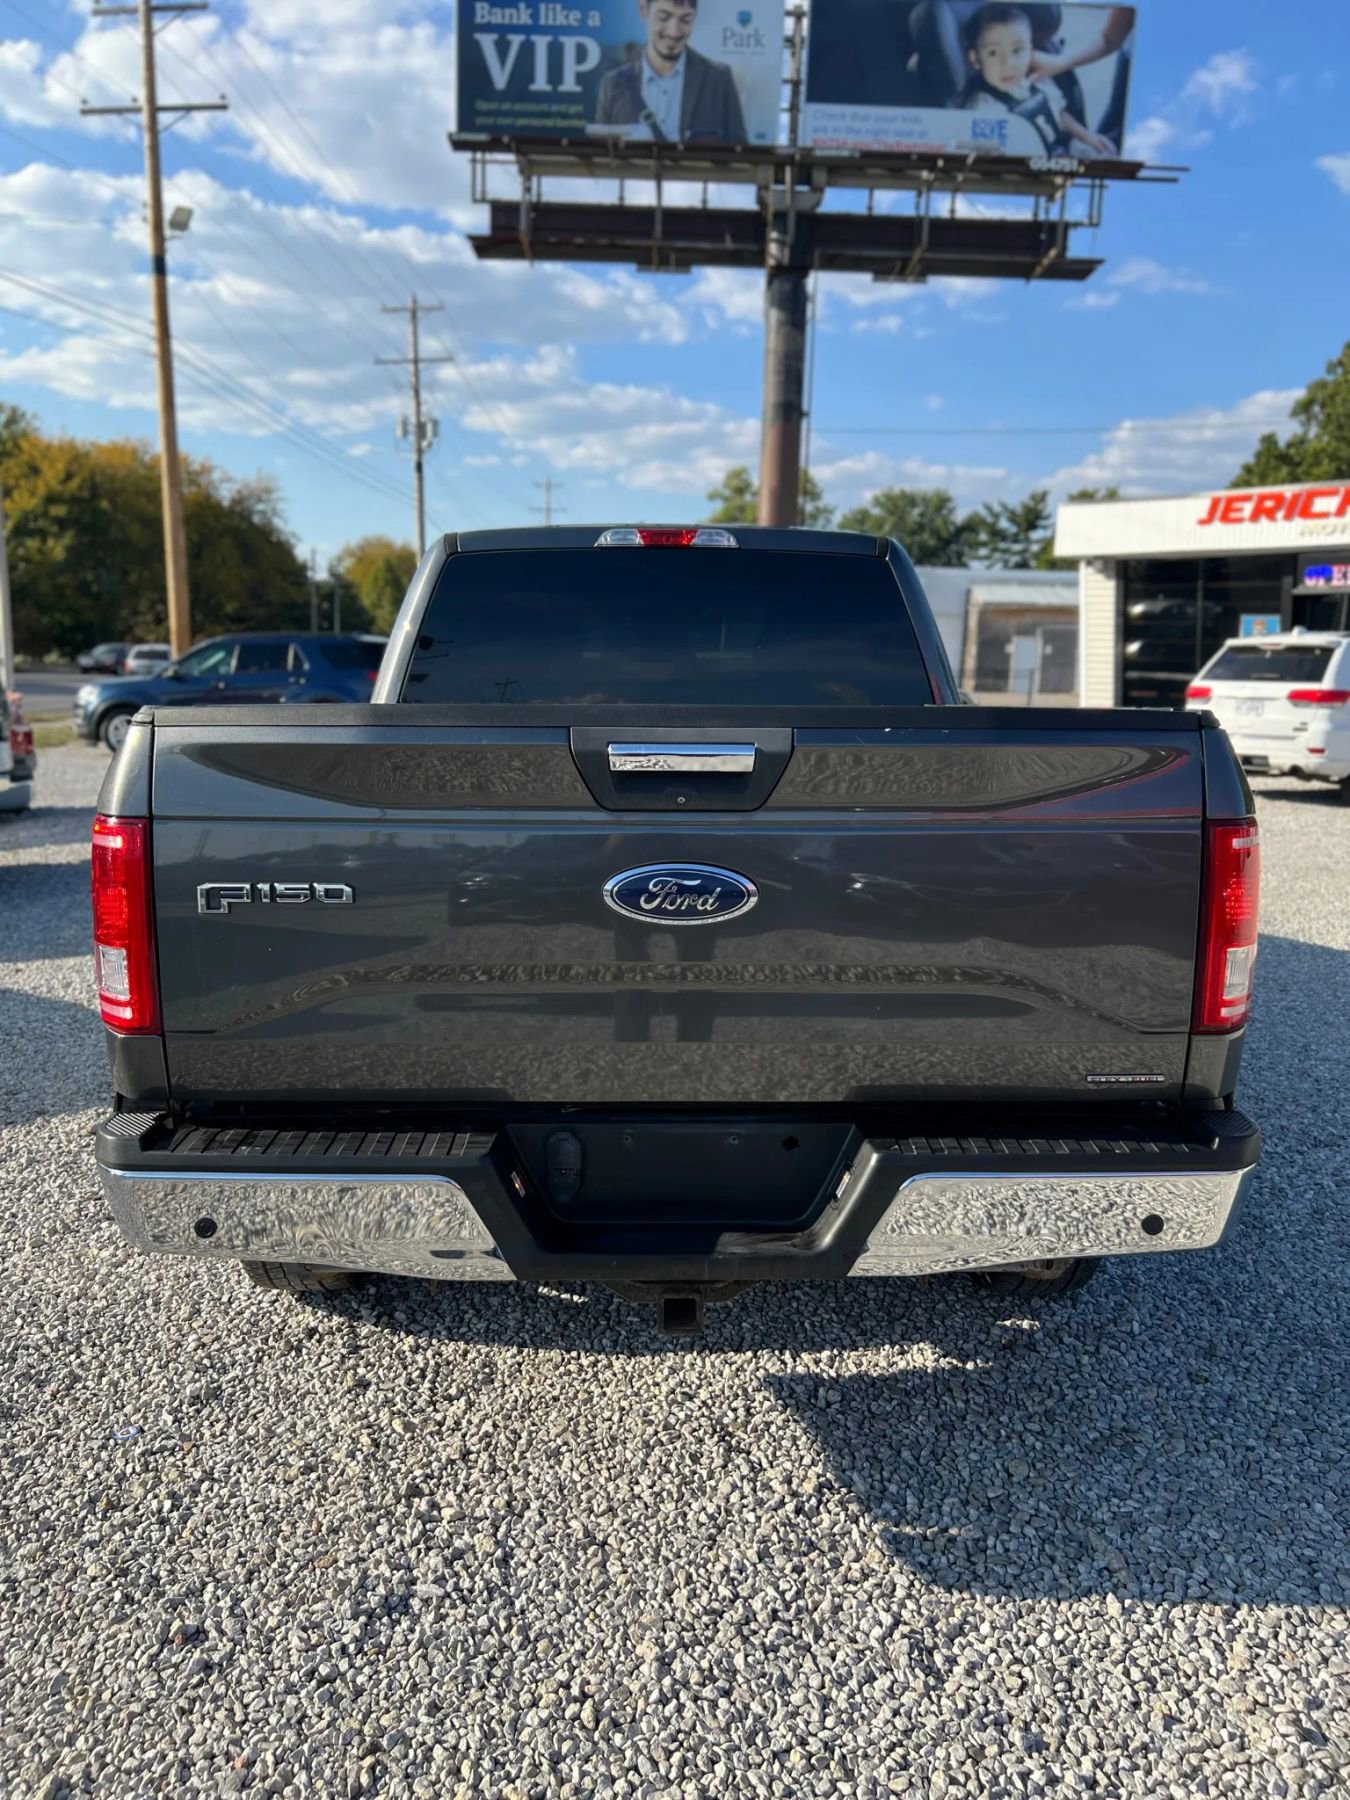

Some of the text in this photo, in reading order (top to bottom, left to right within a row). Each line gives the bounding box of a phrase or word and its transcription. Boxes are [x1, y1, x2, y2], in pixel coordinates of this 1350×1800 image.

[474, 1, 601, 27] Bank like a
[722, 27, 766, 49] Park
[473, 32, 601, 93] VIP
[640, 876, 722, 911] Ford
